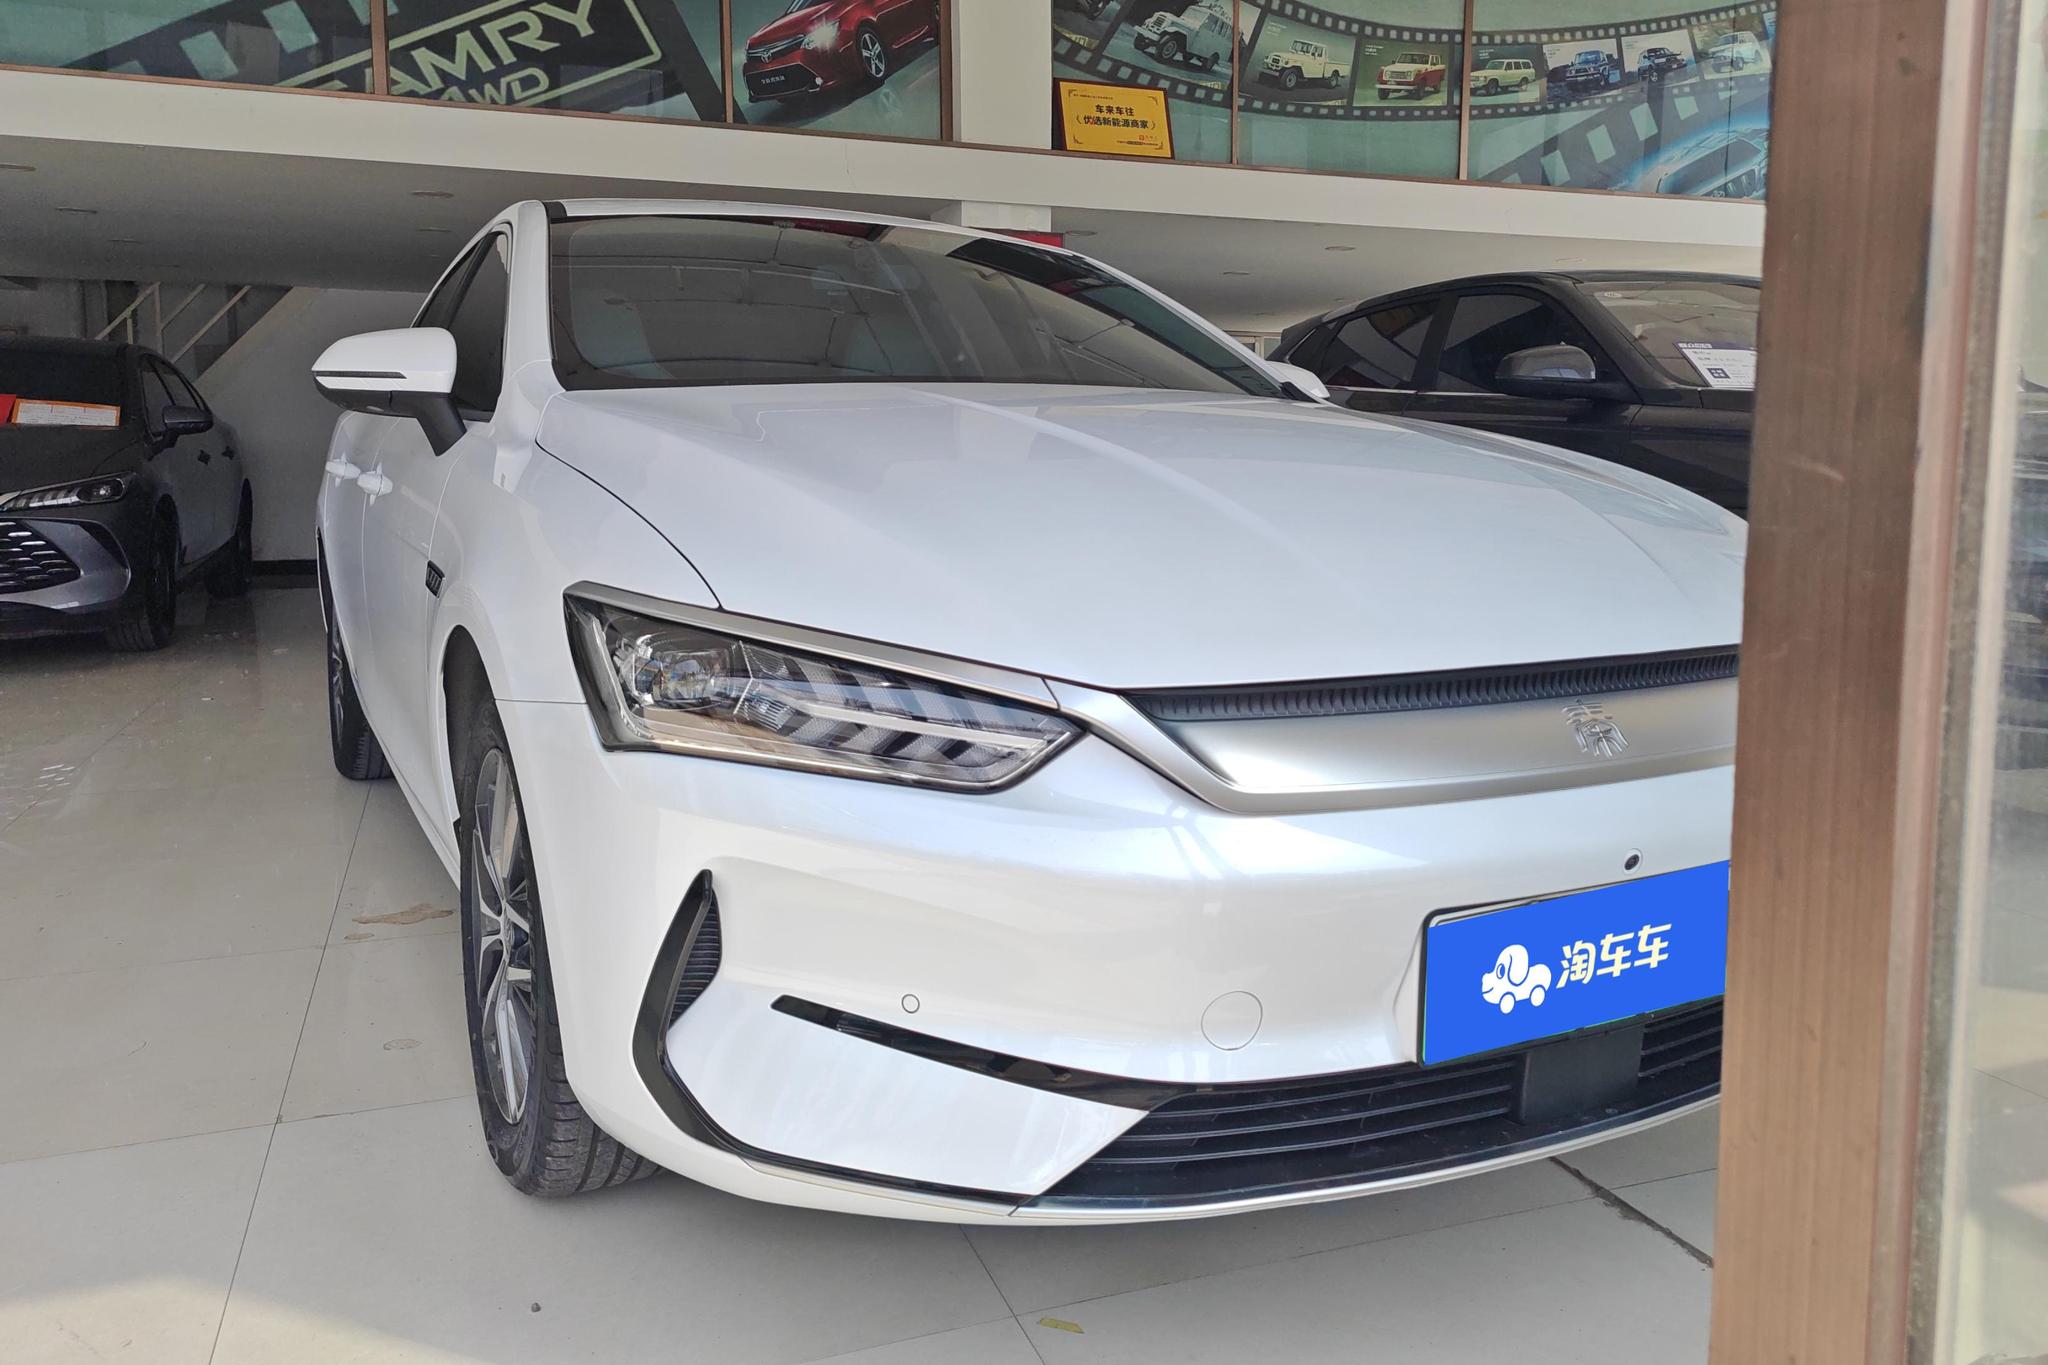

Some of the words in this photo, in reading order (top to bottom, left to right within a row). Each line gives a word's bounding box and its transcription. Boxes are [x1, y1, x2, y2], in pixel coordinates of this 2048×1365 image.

[313, 0, 593, 94] AMRY
[1095, 104, 1135, 117] 车来车往
